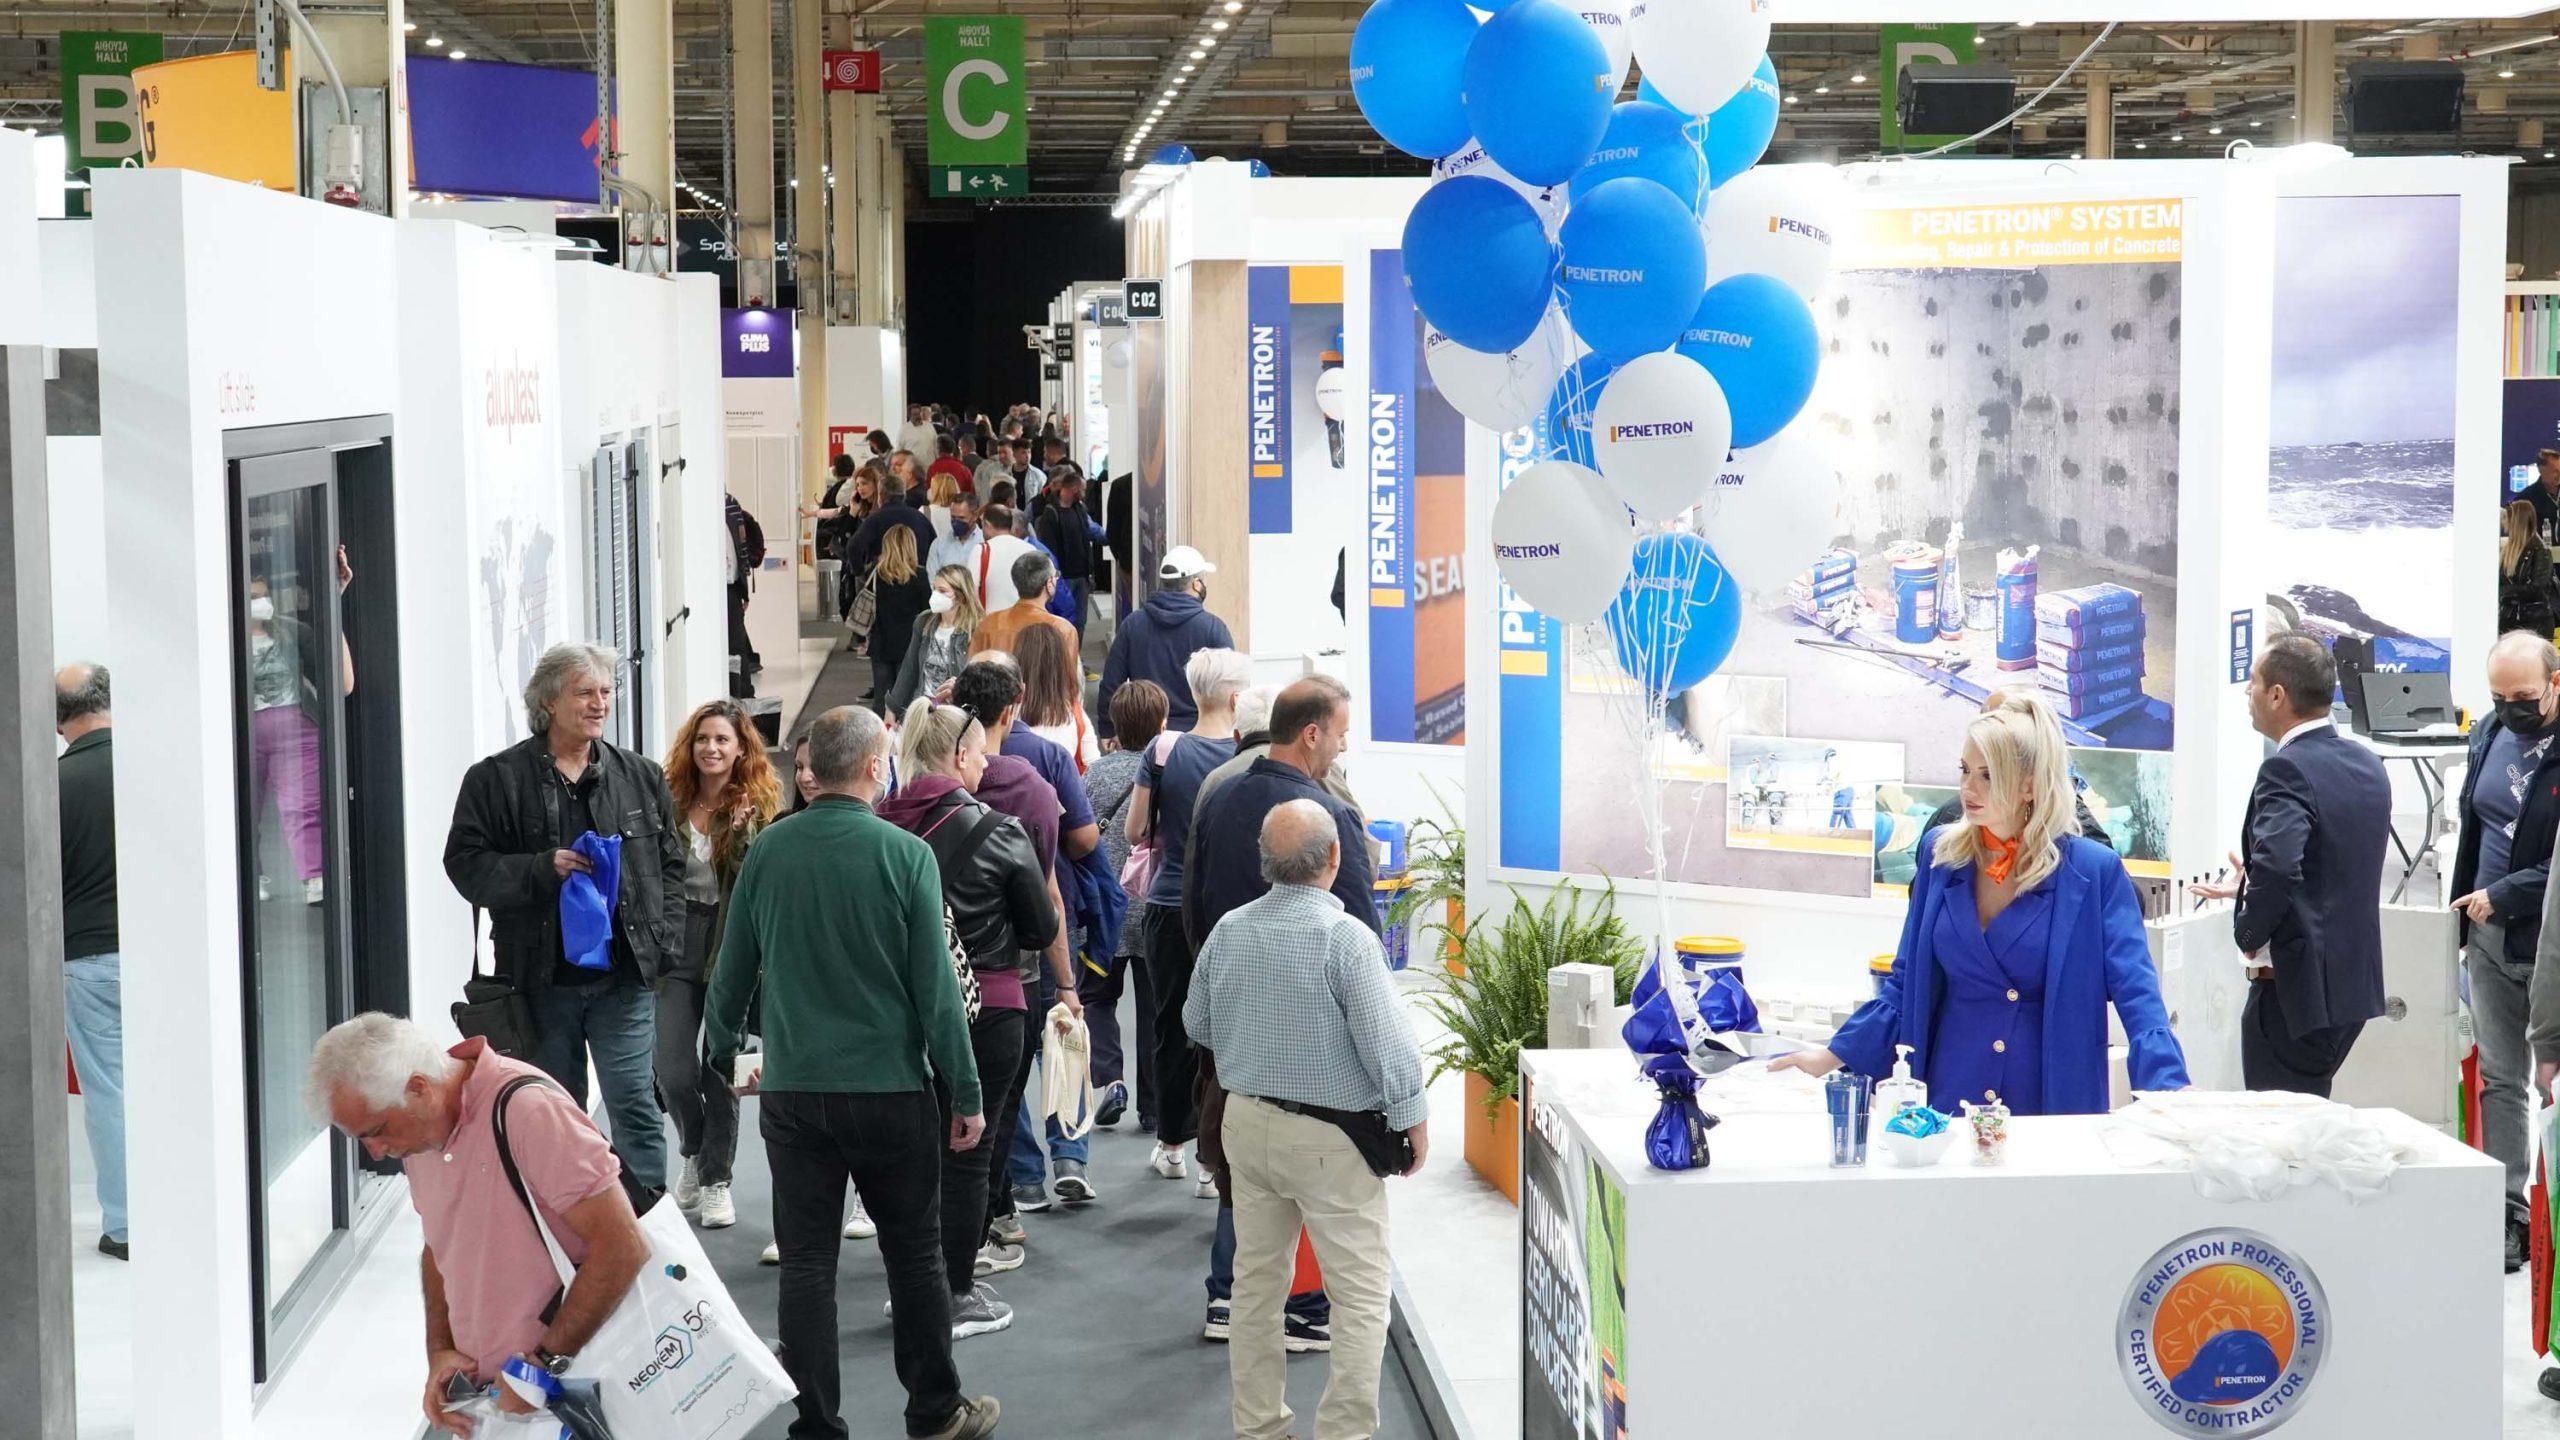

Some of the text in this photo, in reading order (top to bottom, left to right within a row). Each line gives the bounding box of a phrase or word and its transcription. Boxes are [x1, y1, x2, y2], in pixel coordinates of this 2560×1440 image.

[96, 53, 121, 62] HALL
[960, 37, 984, 46] HALL
[78, 75, 142, 157] B
[943, 59, 1010, 140] C
[2070, 204, 2181, 230] SYSTEM
[1947, 240, 1993, 259] Repair
[1999, 240, 2009, 257] &
[2015, 238, 2090, 256] Protection
[2094, 238, 2108, 254] of
[2113, 236, 2180, 254] Concrete
[1565, 265, 1644, 283] PENETRON
[1131, 292, 1156, 307] C 02
[740, 334, 769, 342] CLIMA
[741, 341, 770, 352] PLUS
[1684, 329, 1752, 349] PENETRON
[486, 348, 541, 444] aluplast
[1253, 326, 1275, 461] PENETRON
[1618, 421, 1693, 438] PENETRON
[1371, 393, 1396, 584] PENETRON
[1497, 544, 1560, 559] PENETRON
[1414, 553, 1465, 601] SEA
[1527, 1176, 1580, 1294] TOWARDS
[1527, 1239, 1552, 1320] ZERO
[2140, 1241, 2316, 1349] PENETRON PROFESSIONAL
[628, 1342, 679, 1391] NEOKEM
[1527, 1298, 1582, 1428] CONCRETE
[2131, 1329, 2303, 1428] CERTIFIED CONTRACTOR
[2220, 1375, 2266, 1385] PENETRON
